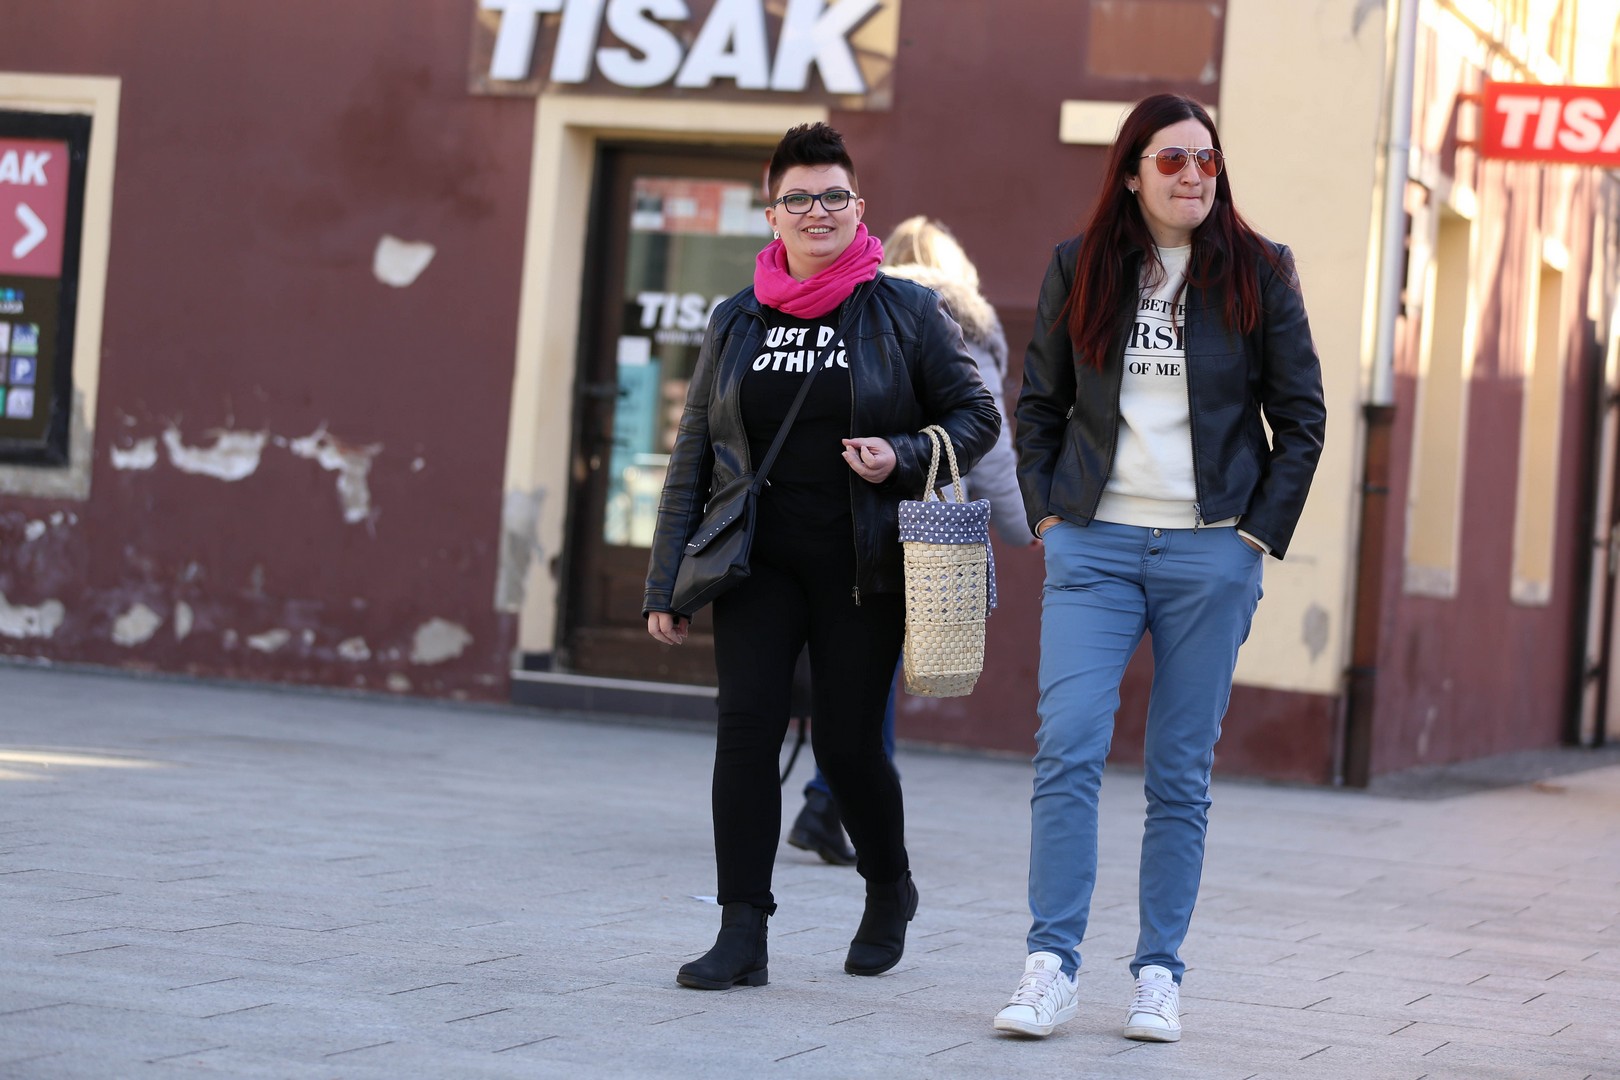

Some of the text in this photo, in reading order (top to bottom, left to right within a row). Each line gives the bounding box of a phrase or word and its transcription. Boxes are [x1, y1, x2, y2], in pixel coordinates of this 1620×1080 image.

[481, 0, 872, 93] TISAK
[0, 149, 52, 186] AK
[816, 325, 845, 347] D
[1128, 362, 1181, 376] OF ME
